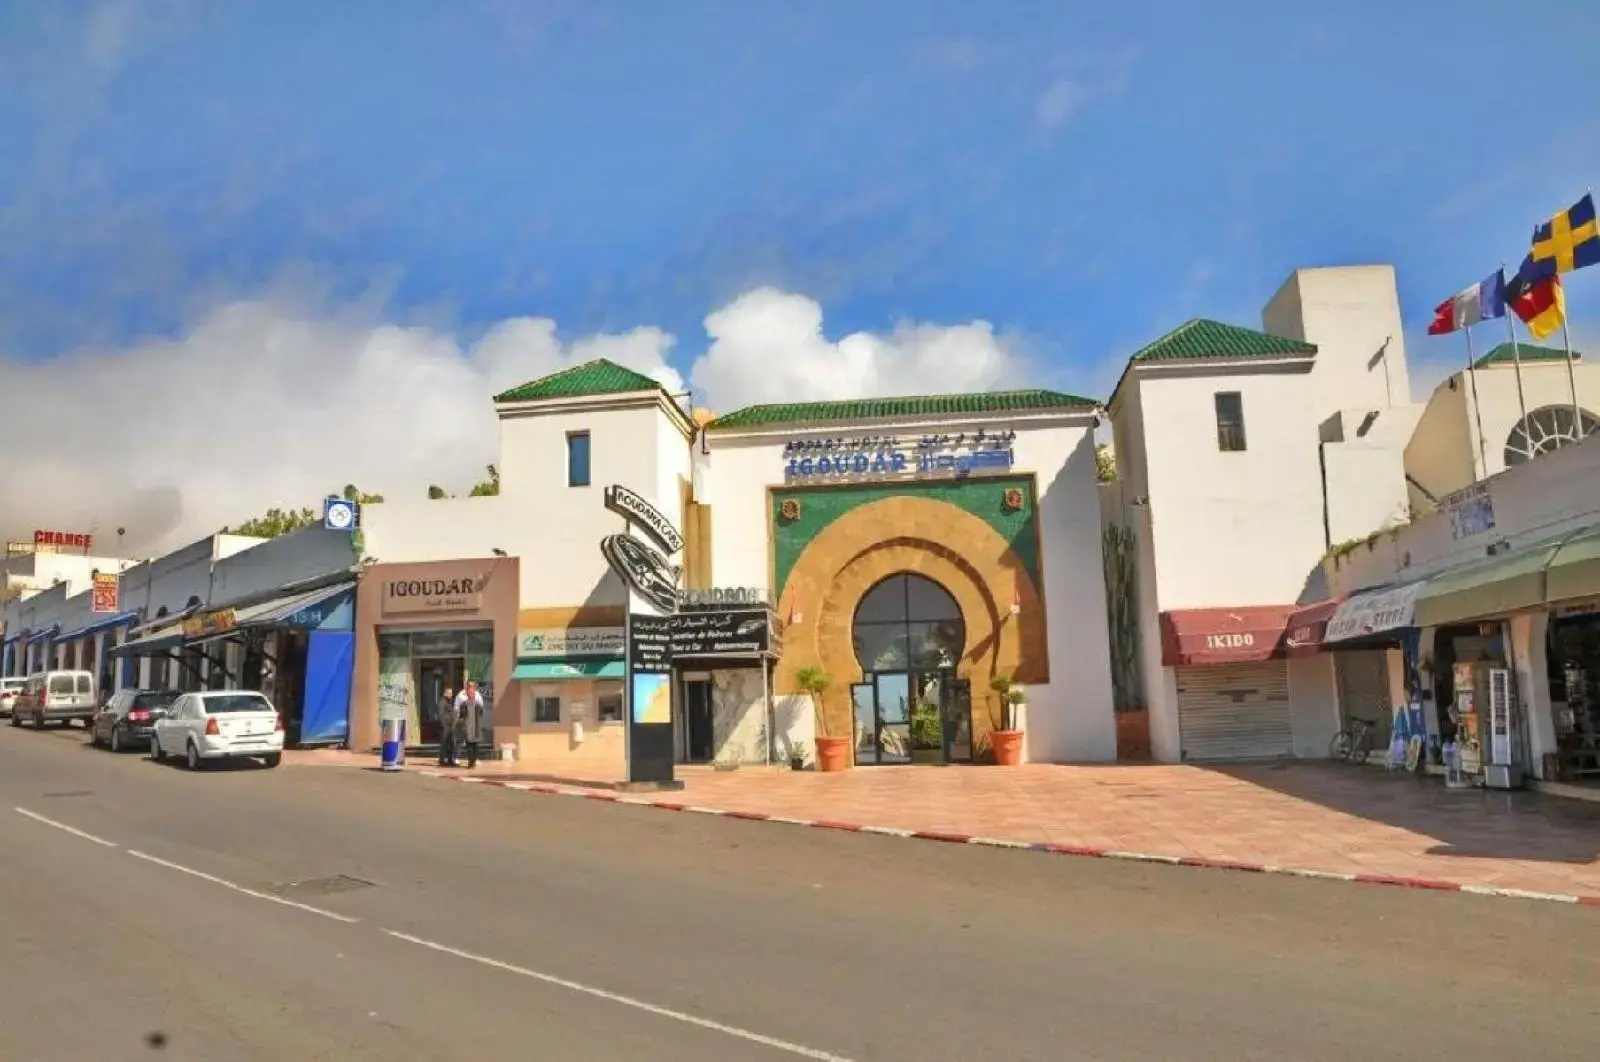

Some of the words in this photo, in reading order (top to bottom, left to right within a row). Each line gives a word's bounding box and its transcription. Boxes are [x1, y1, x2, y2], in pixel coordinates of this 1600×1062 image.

[790, 452, 907, 475] IGOUDAR
[34, 530, 92, 548] CHANGE
[389, 578, 474, 597] IGOUDAR
[1207, 634, 1254, 648] IKIBO
